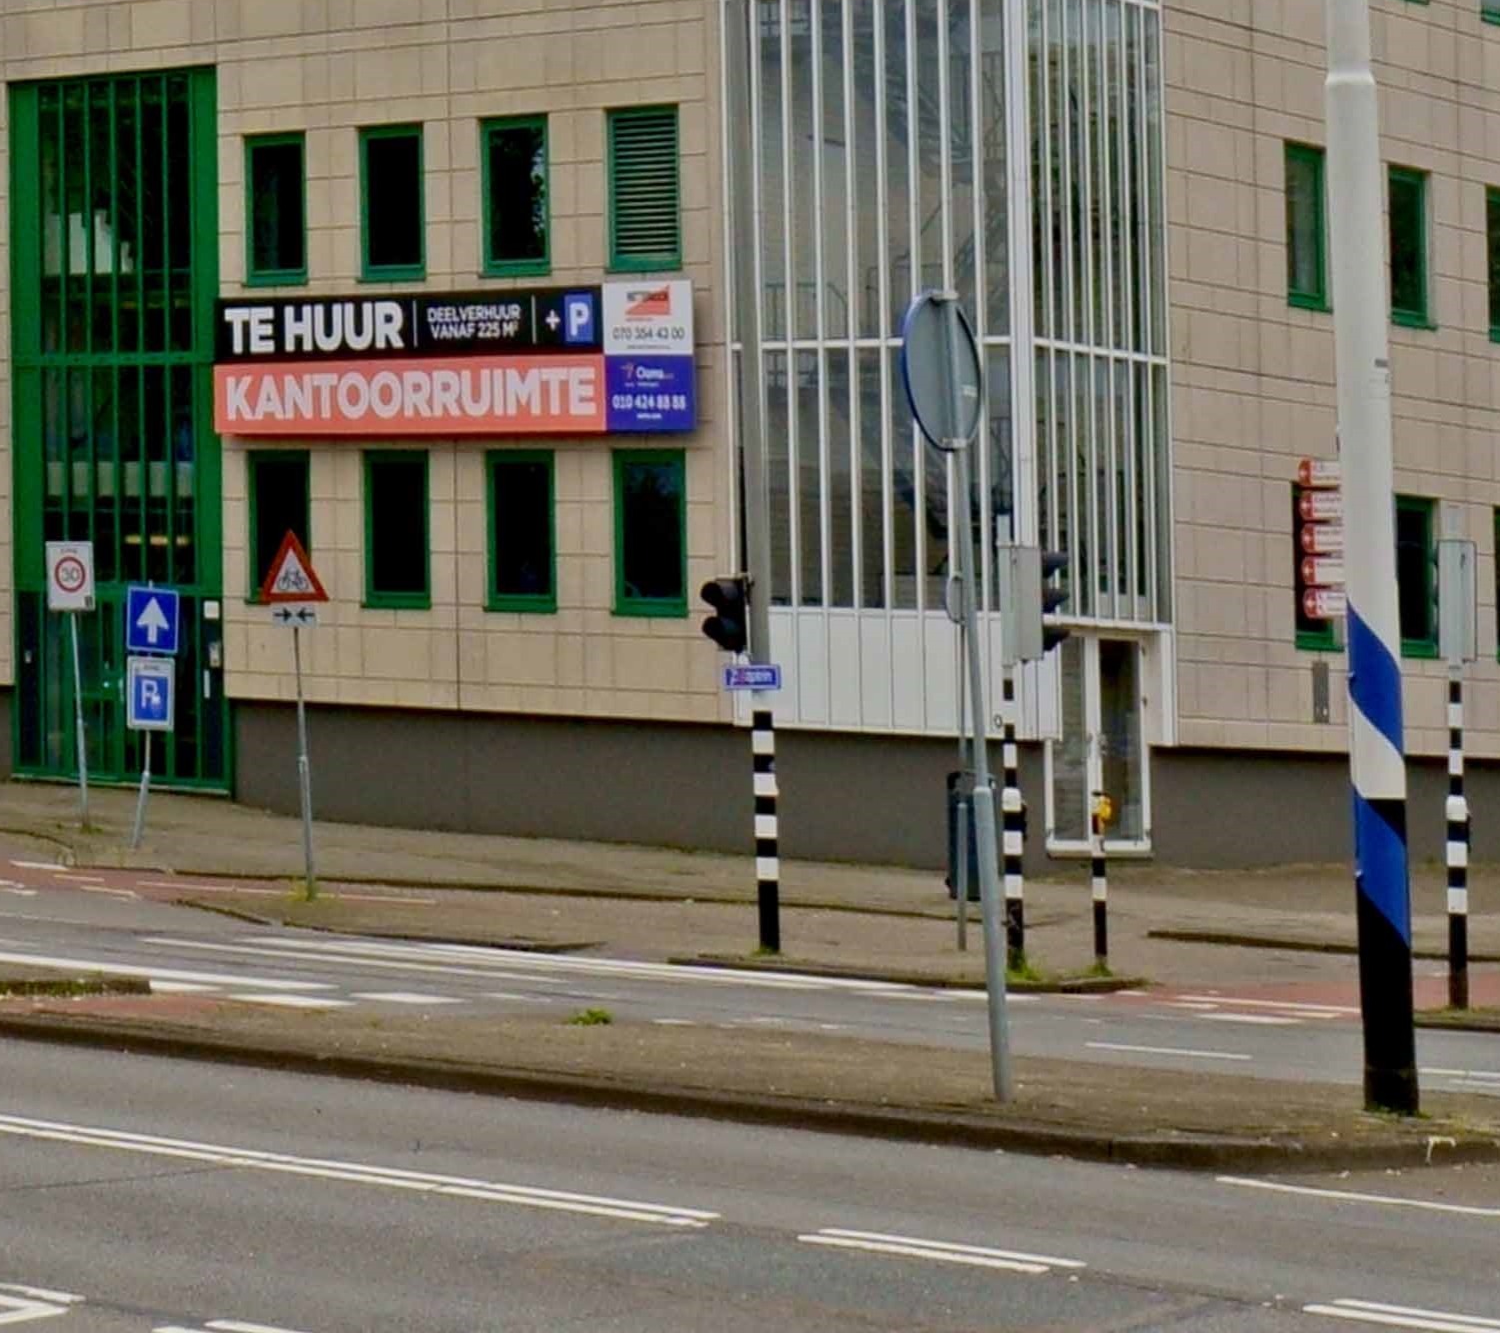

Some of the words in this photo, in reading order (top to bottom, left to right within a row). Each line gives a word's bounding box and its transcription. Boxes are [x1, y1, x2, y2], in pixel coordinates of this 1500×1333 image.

[224, 306, 276, 355] TE
[283, 300, 404, 353] HUUR
[430, 321, 476, 341] VANAF
[477, 321, 501, 339] 225
[568, 302, 590, 336] P
[225, 364, 598, 421] KANTOORRUIMTE
[61, 566, 80, 583] 30
